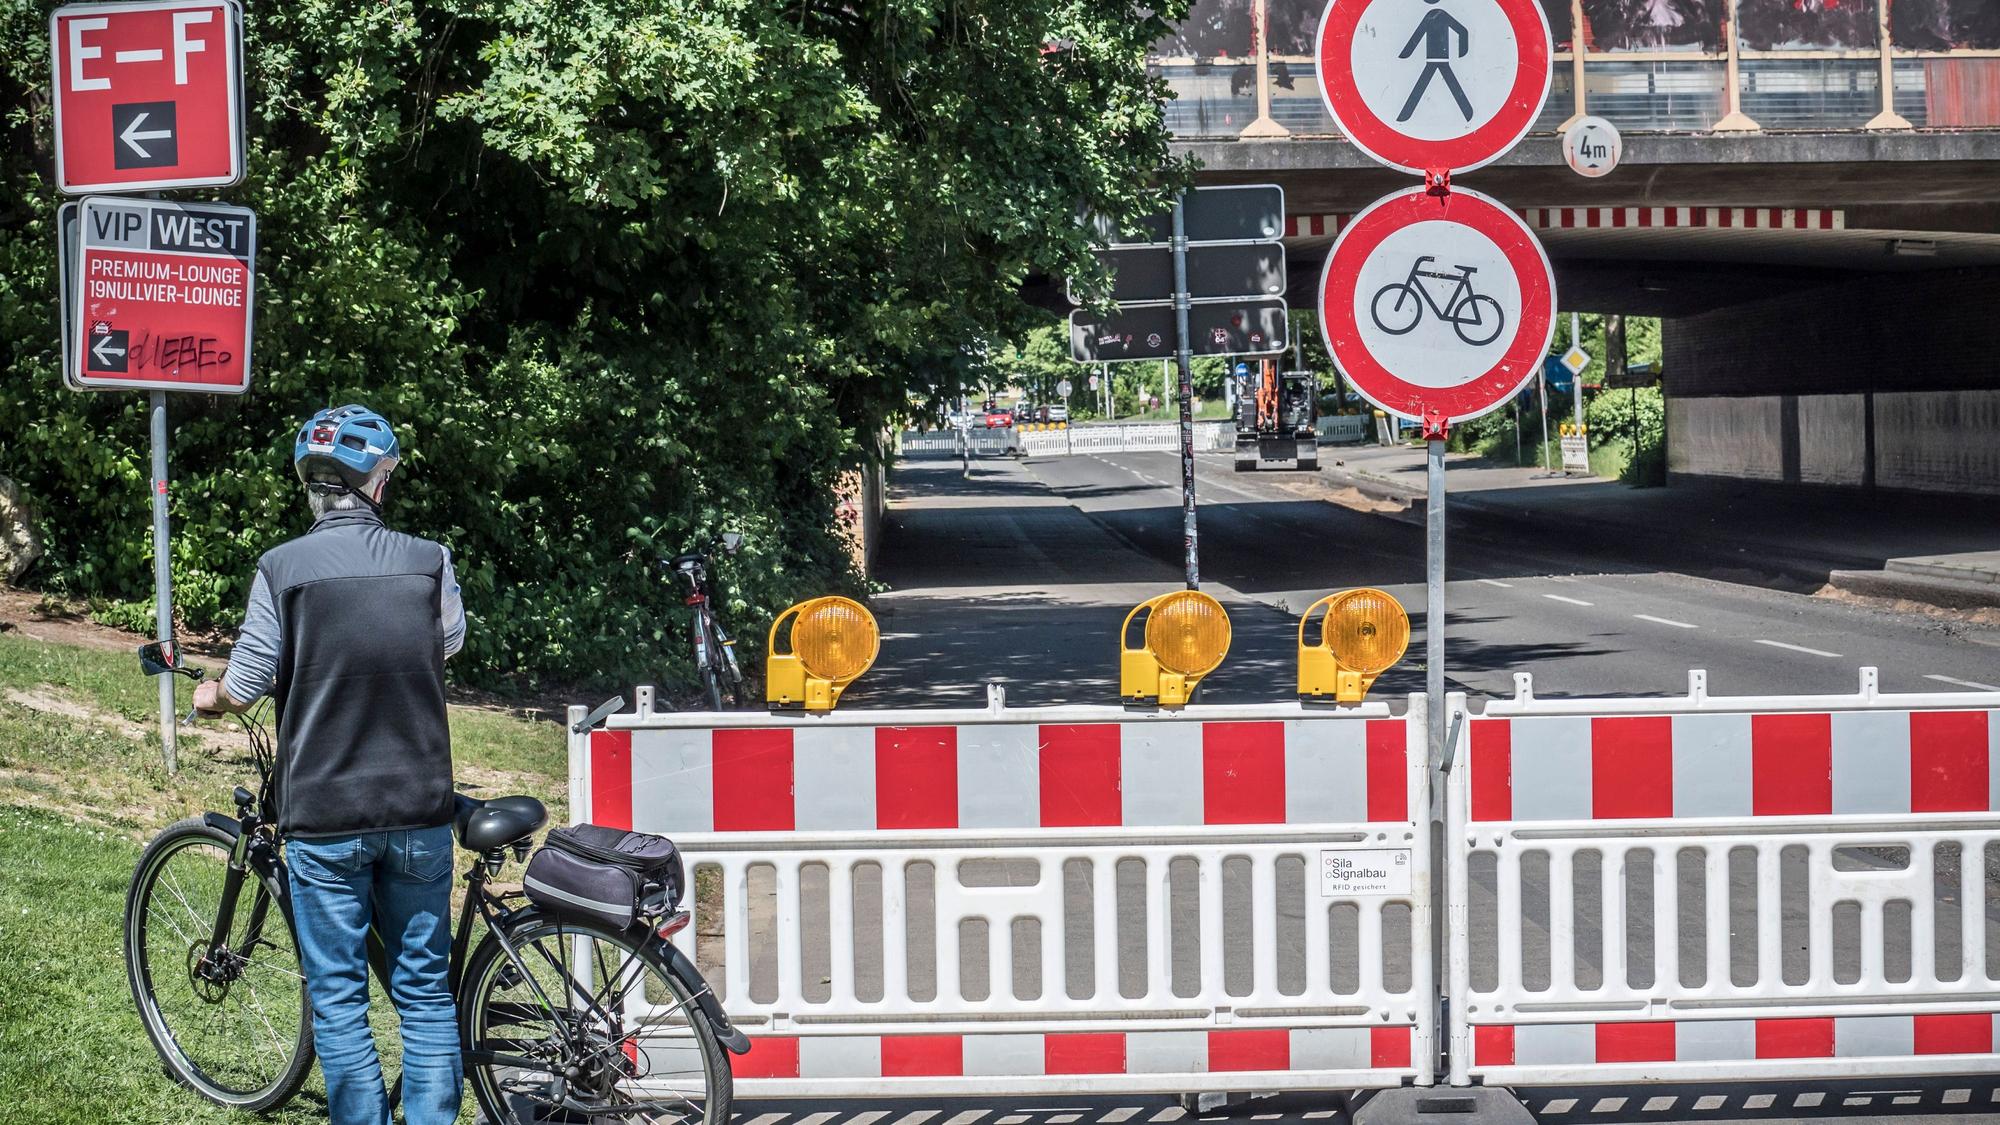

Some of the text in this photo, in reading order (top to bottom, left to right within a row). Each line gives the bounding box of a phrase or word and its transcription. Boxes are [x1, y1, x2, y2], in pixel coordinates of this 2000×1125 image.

[1580, 135, 1607, 158] 4m
[93, 210, 243, 250] VIP WEST
[91, 258, 242, 286] PREMIUM-LOUNGE
[89, 280, 242, 307] 19NULLVIER-LOUNGE
[1332, 858, 1353, 868] Sila
[1332, 868, 1387, 881] Signalbau
[1353, 883, 1387, 892] gesichert
